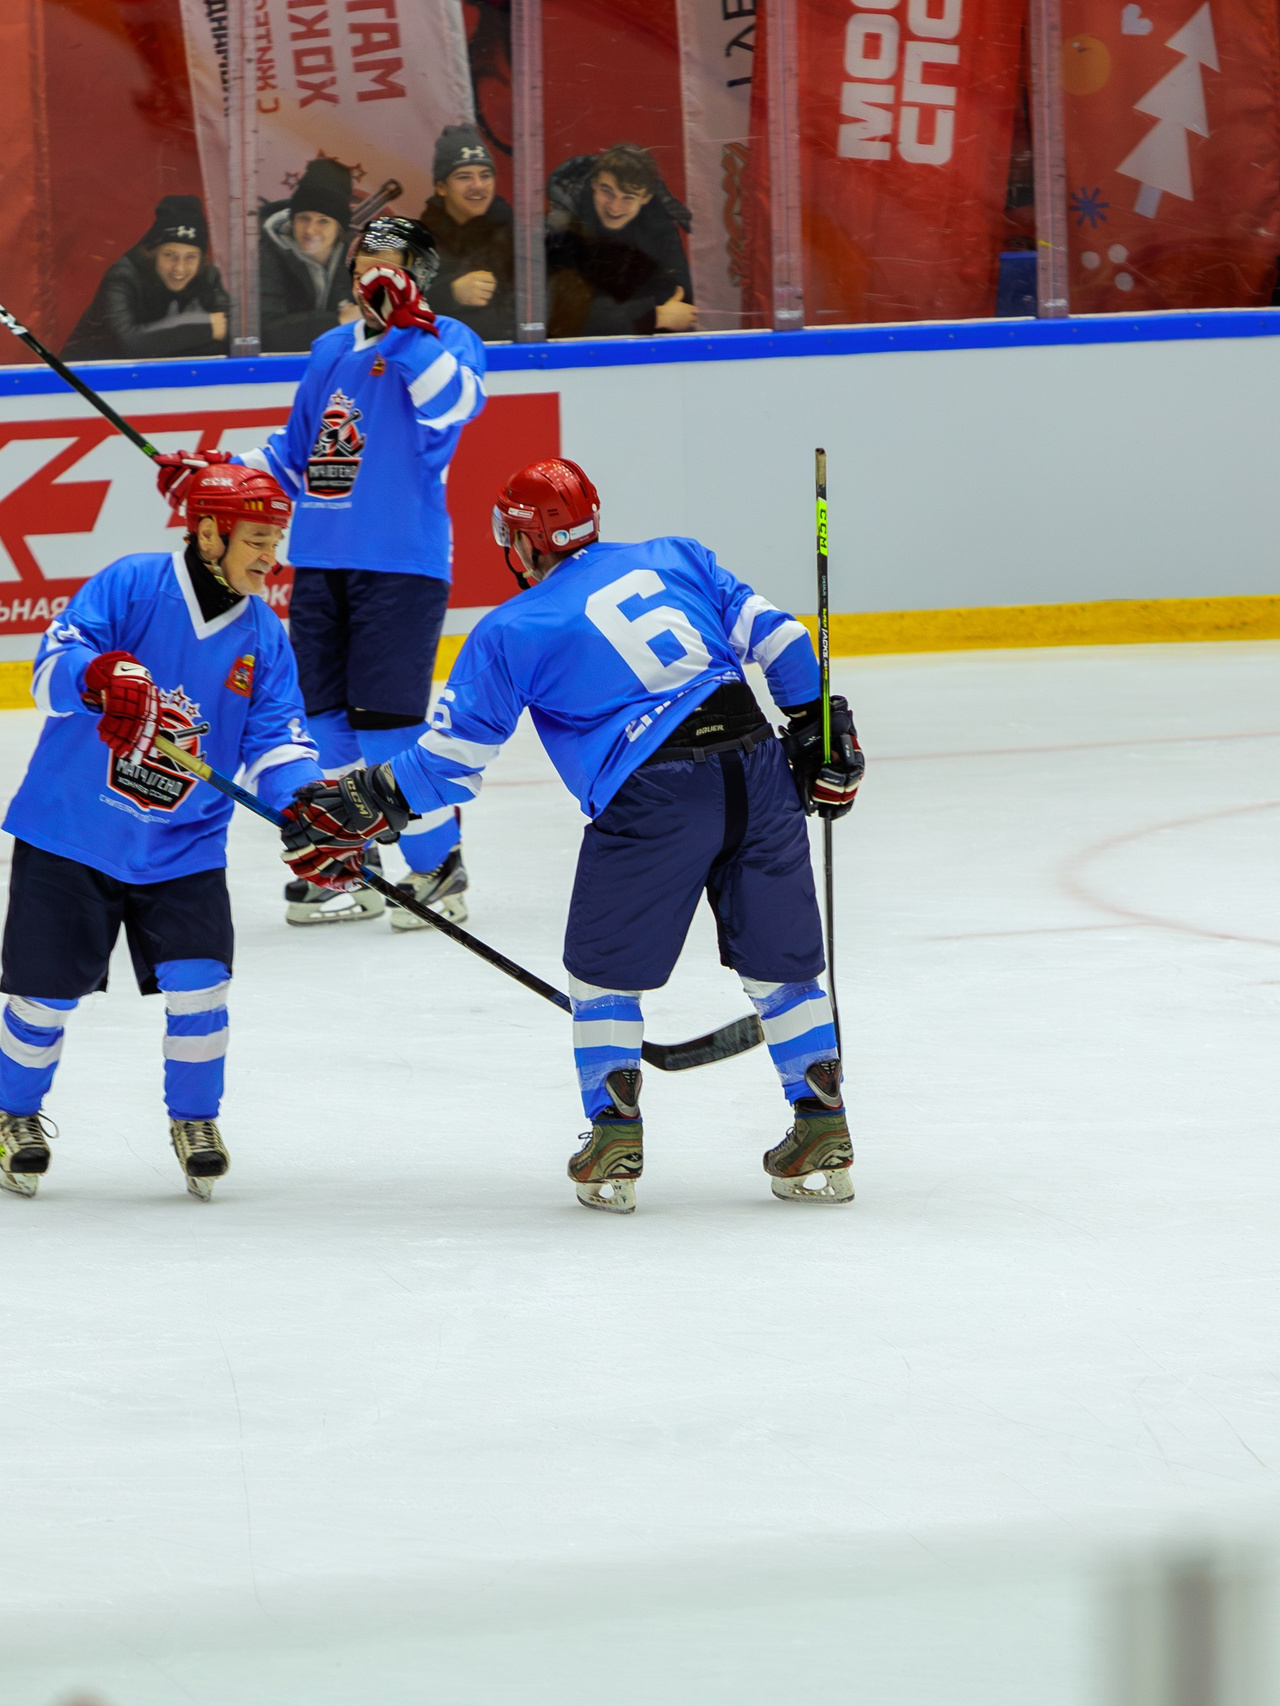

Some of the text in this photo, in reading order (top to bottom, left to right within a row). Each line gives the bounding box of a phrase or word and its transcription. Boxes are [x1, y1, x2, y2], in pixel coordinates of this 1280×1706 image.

[585, 569, 714, 694] 6
[696, 725, 725, 737] BAUER
[347, 779, 369, 817] CCM
